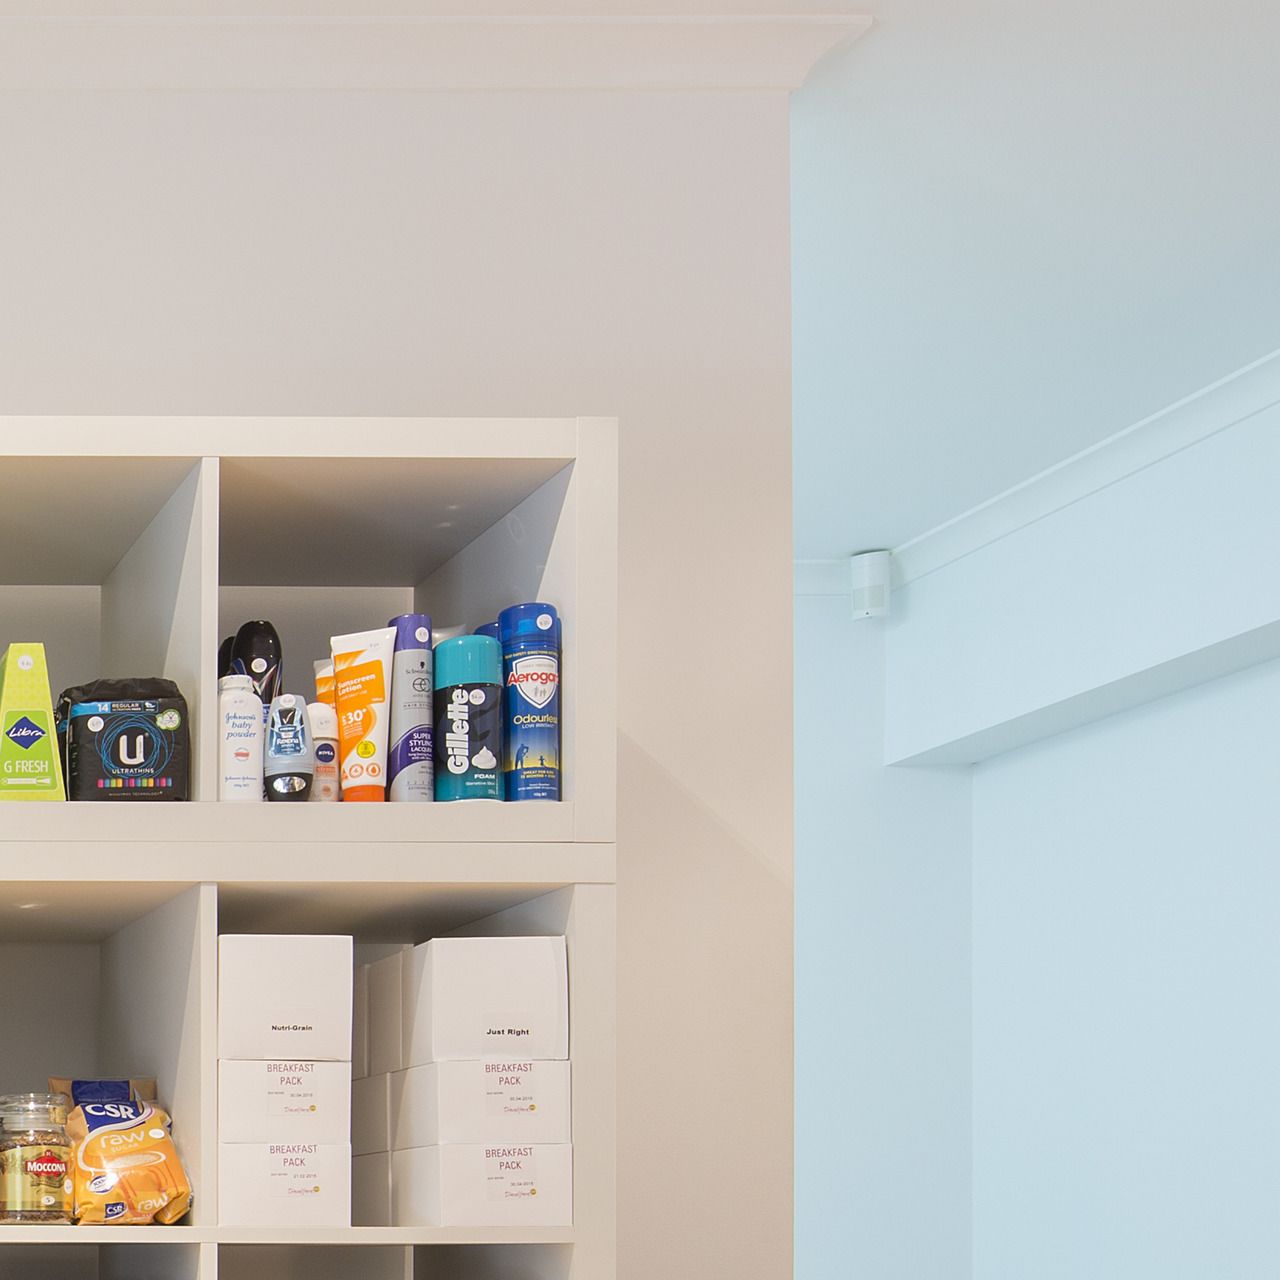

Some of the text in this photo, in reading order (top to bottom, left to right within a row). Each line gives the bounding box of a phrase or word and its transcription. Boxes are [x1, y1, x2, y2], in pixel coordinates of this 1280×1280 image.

[339, 674, 376, 688] Sunscreen
[339, 684, 362, 695] Lotion
[225, 712, 256, 723] Johnson's
[10, 725, 46, 738] Libra
[231, 722, 252, 731] baby
[446, 689, 469, 774] Gillette
[226, 730, 256, 739] powder
[16, 761, 48, 773] FRESH
[267, 1064, 314, 1072] BREAKFAST
[280, 1076, 302, 1085] PACK
[85, 1105, 135, 1119] CSR
[100, 1131, 144, 1149] raw
